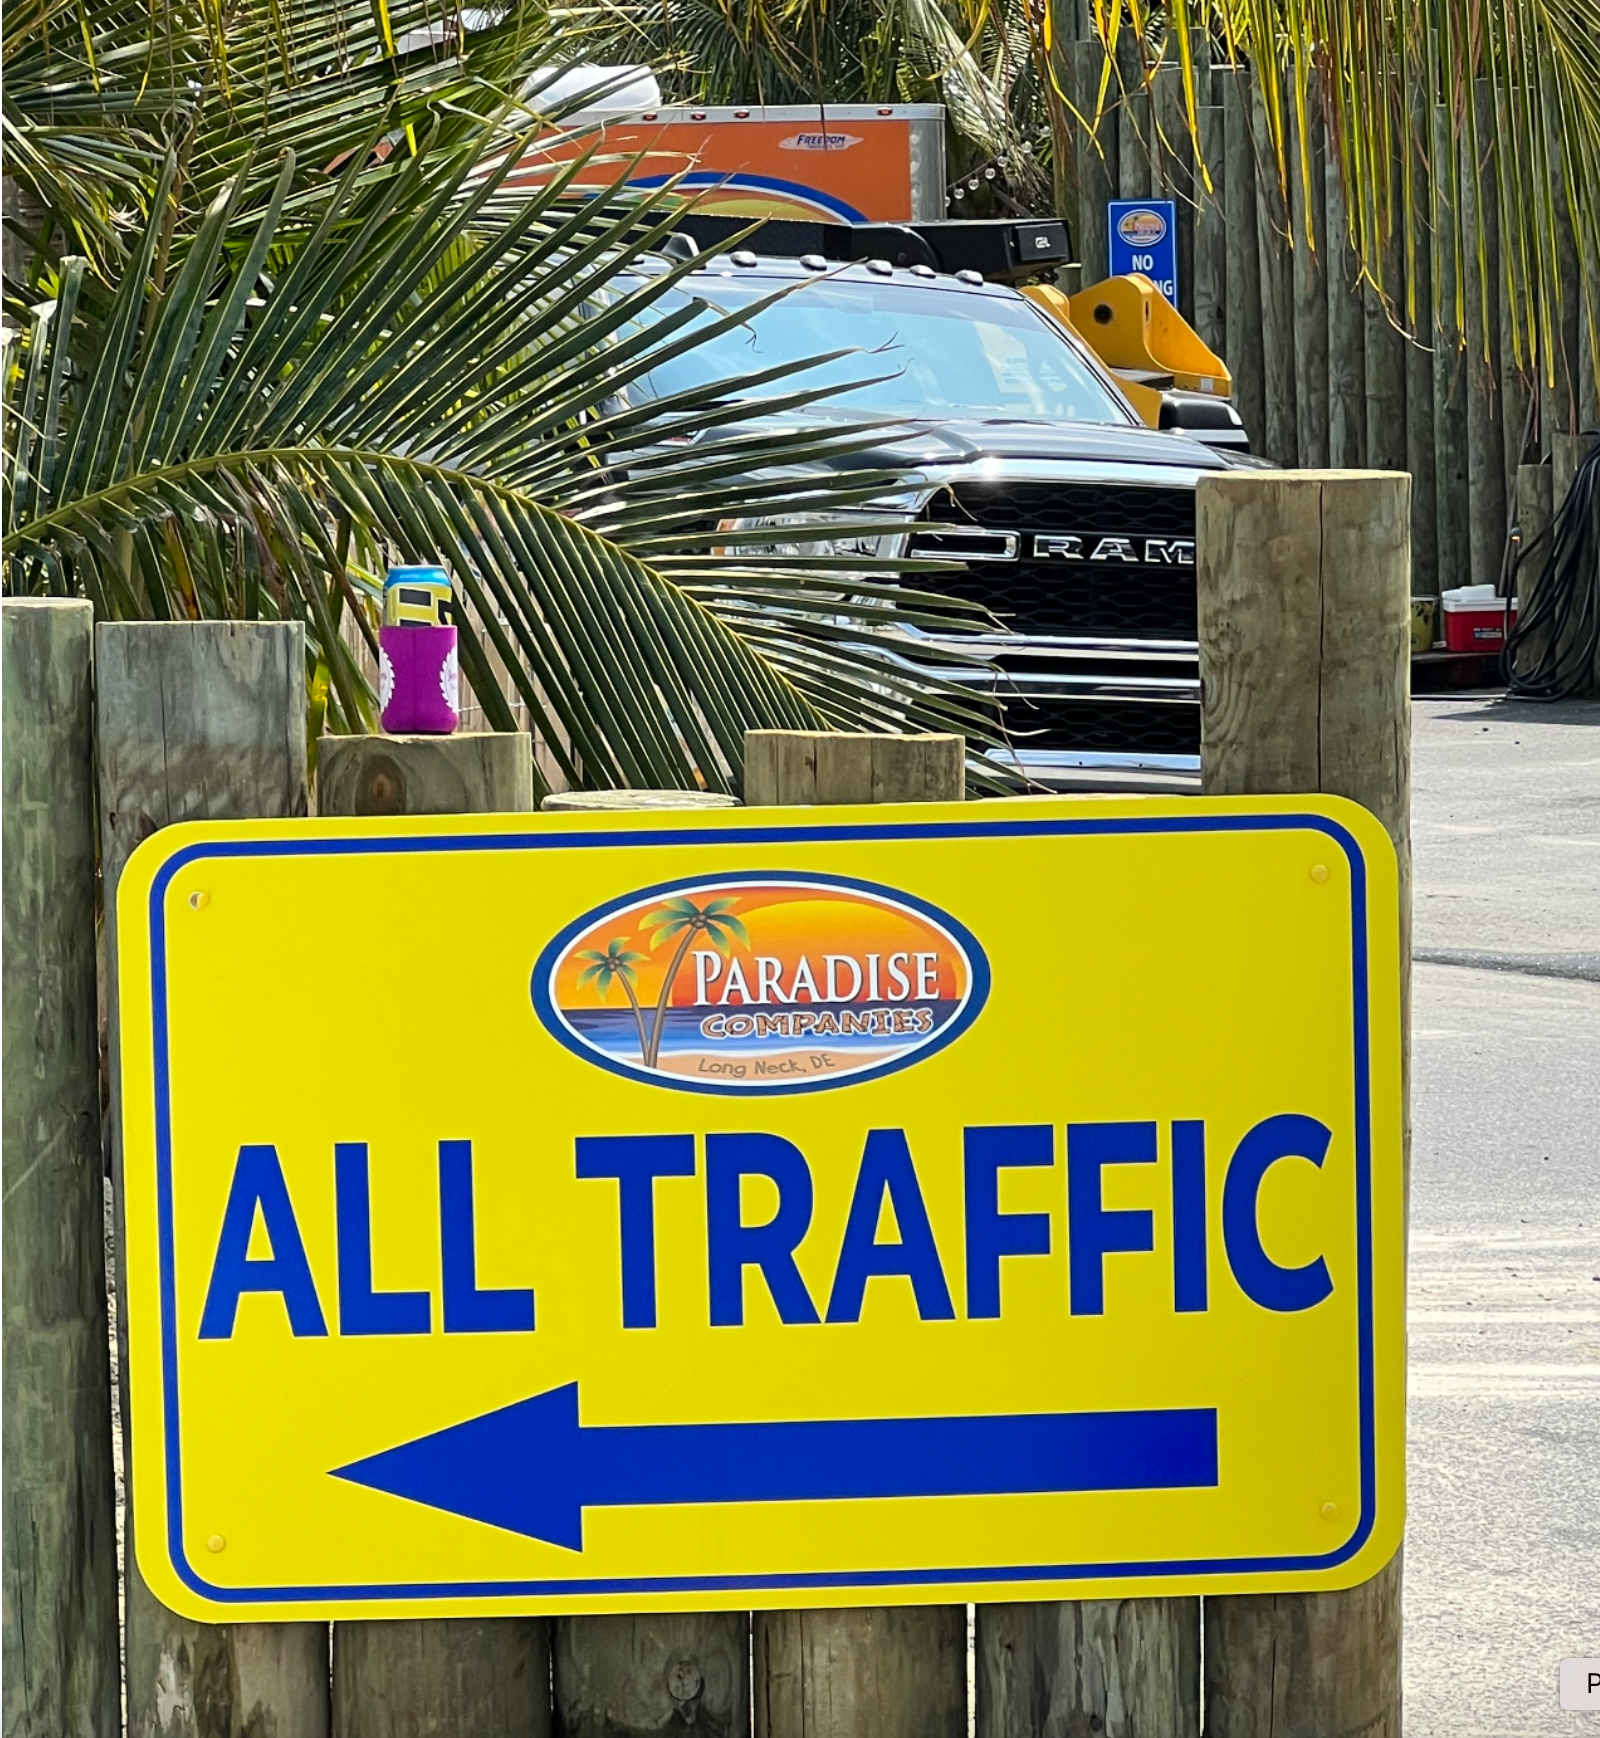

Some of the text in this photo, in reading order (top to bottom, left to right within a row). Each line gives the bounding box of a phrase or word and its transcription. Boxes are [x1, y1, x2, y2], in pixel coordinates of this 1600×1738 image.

[797, 134, 846, 145] FREEDOM
[1132, 254, 1154, 271] NO
[1033, 534, 1196, 564] RAM
[691, 950, 940, 1006] PARADISE
[700, 1007, 934, 1039] COMPANIES
[698, 1053, 836, 1078] Long Neck, DE
[200, 1115, 1333, 1339] ALL TRAFFIC
